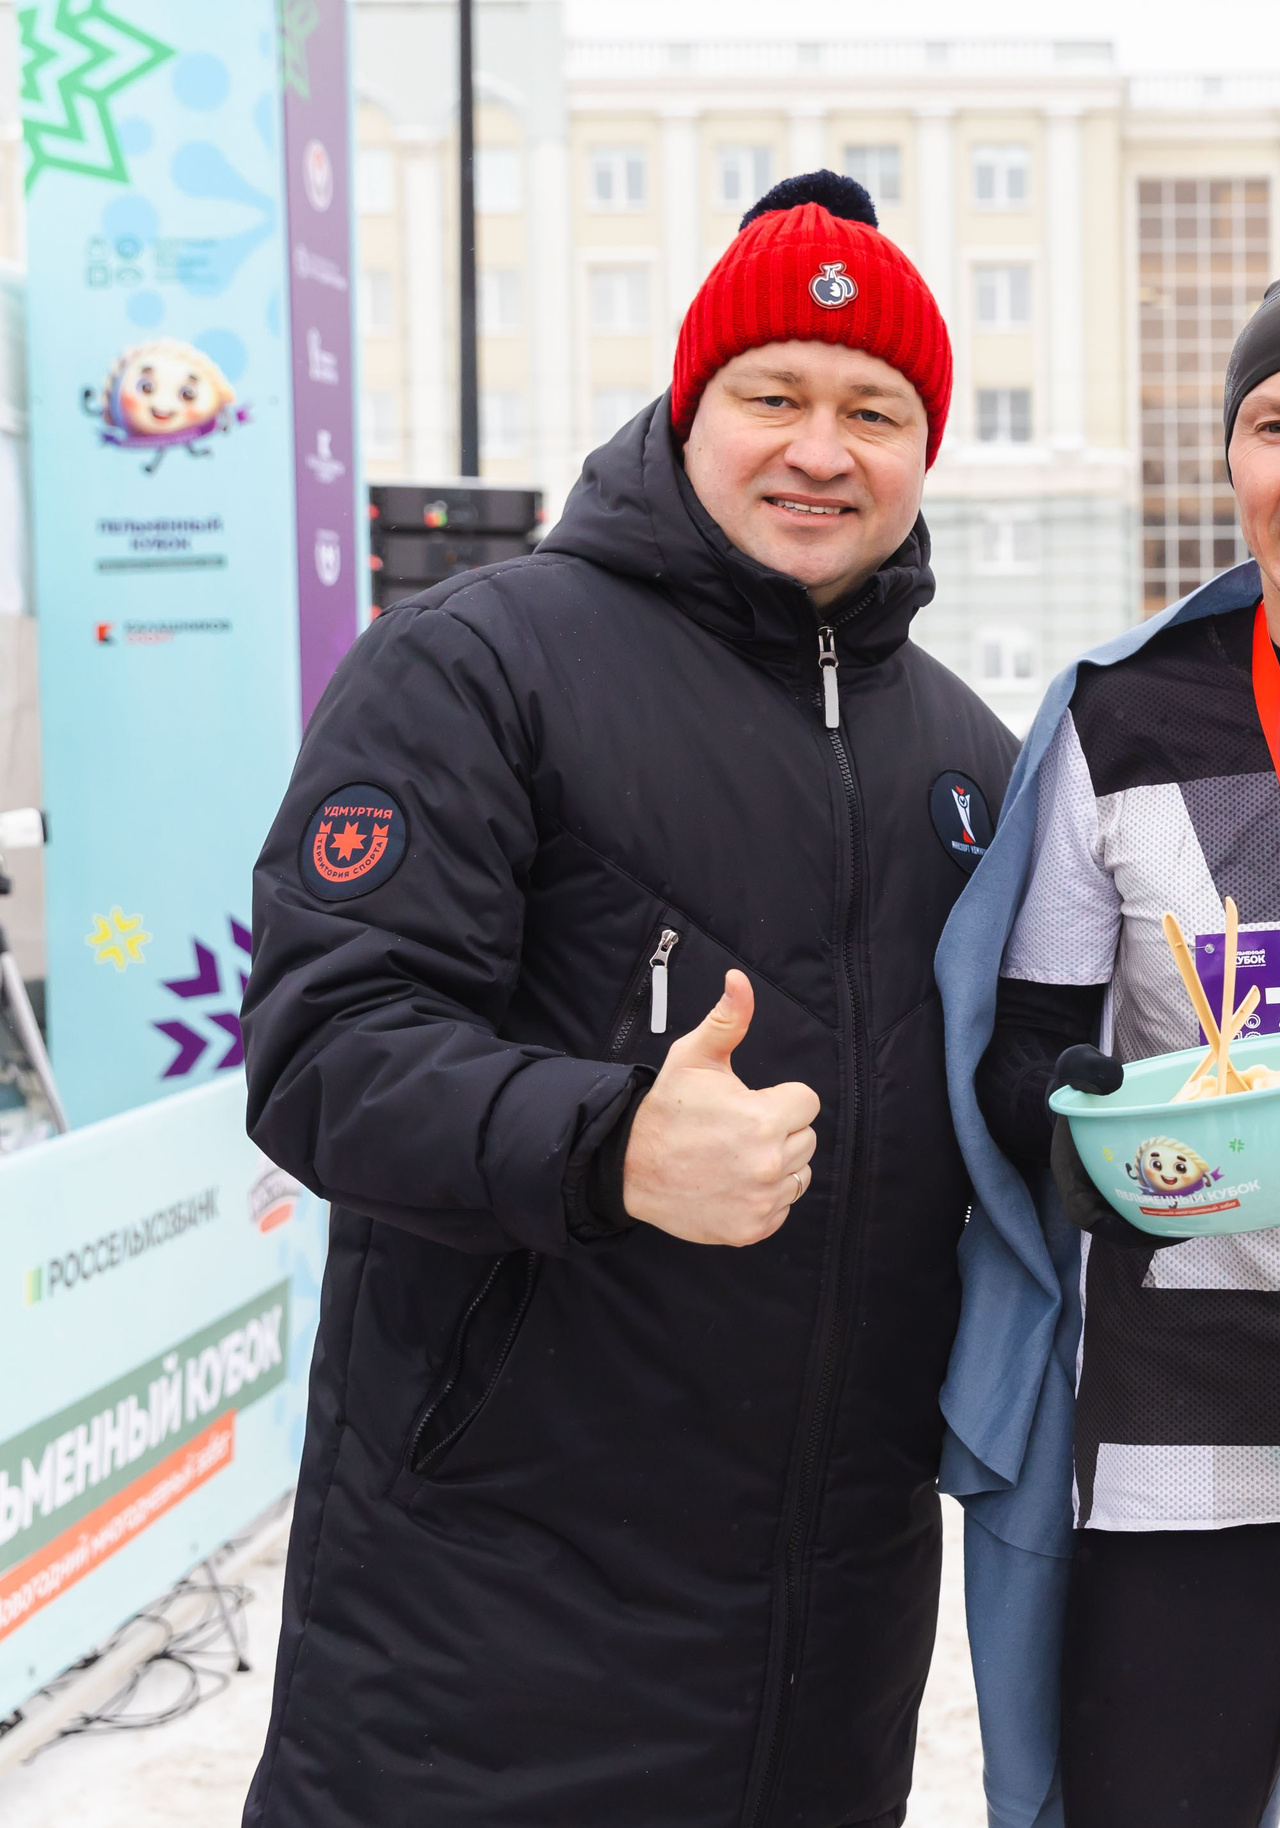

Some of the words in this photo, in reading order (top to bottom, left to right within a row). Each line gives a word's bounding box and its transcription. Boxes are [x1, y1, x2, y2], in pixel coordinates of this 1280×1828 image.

[323, 806, 393, 819] УДМУРТИЯ
[316, 838, 350, 878] ТЕРРИТОРИЯ
[352, 841, 384, 875] СПОРТА
[1115, 1188, 1206, 1207] ПЕЛЬМЕННЫЙ
[1207, 1179, 1261, 1202] КУБОК
[47, 1185, 220, 1296] РОССЕЛЬХОЗБАНК
[185, 1304, 283, 1424] КУБОК
